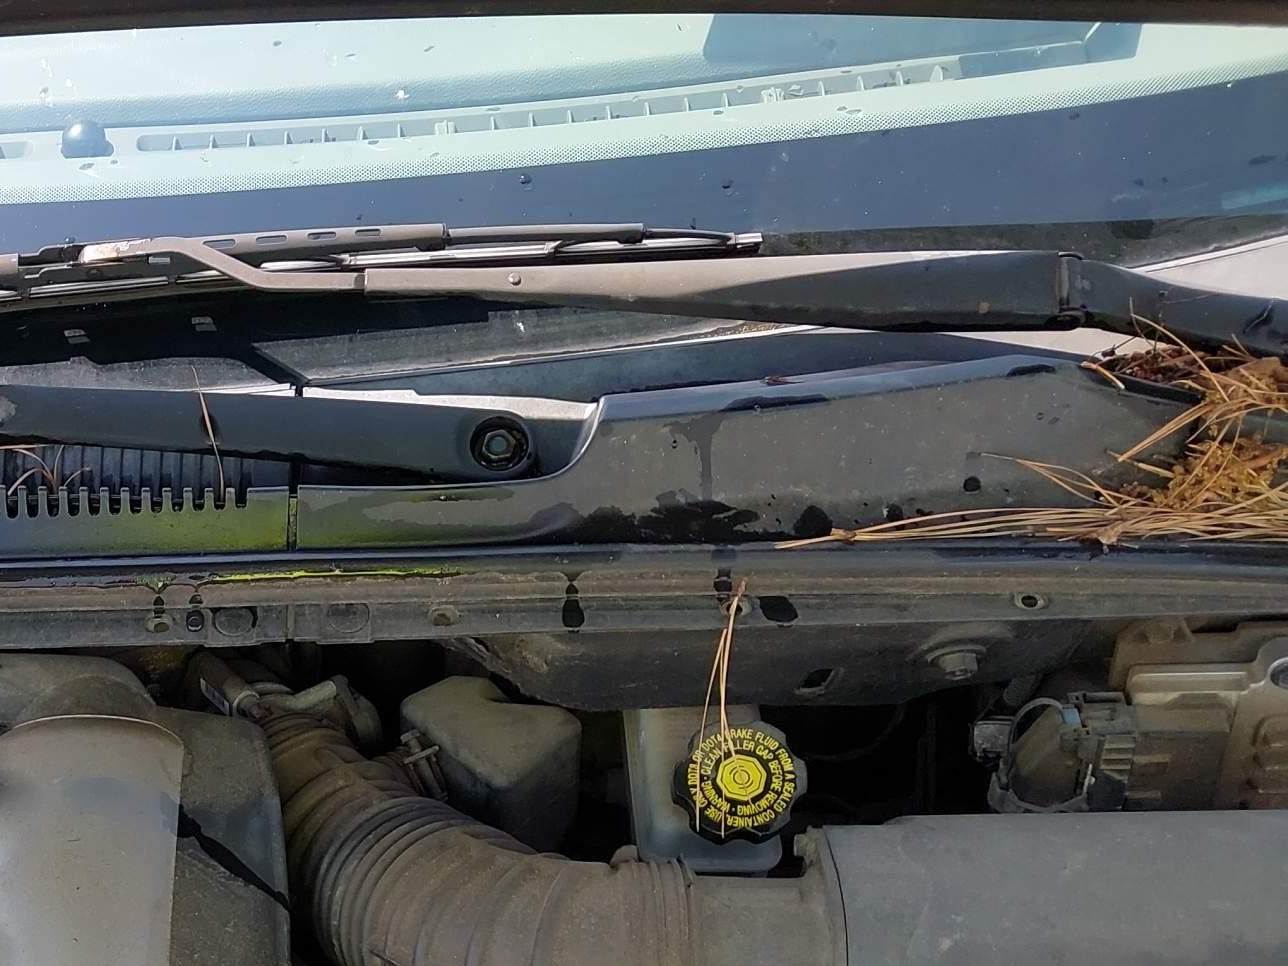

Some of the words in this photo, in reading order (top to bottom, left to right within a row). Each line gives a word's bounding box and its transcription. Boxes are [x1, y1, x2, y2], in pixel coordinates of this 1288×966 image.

[755, 732, 779, 750] FLUID
[755, 745, 774, 761] CAP
[701, 747, 722, 775] CLEAN
[776, 749, 794, 772] FROM
[769, 760, 783, 792] BEFORE
[701, 781, 731, 812] WARNING
[737, 790, 777, 816] REMOVING
[774, 781, 795, 812] SEALED
